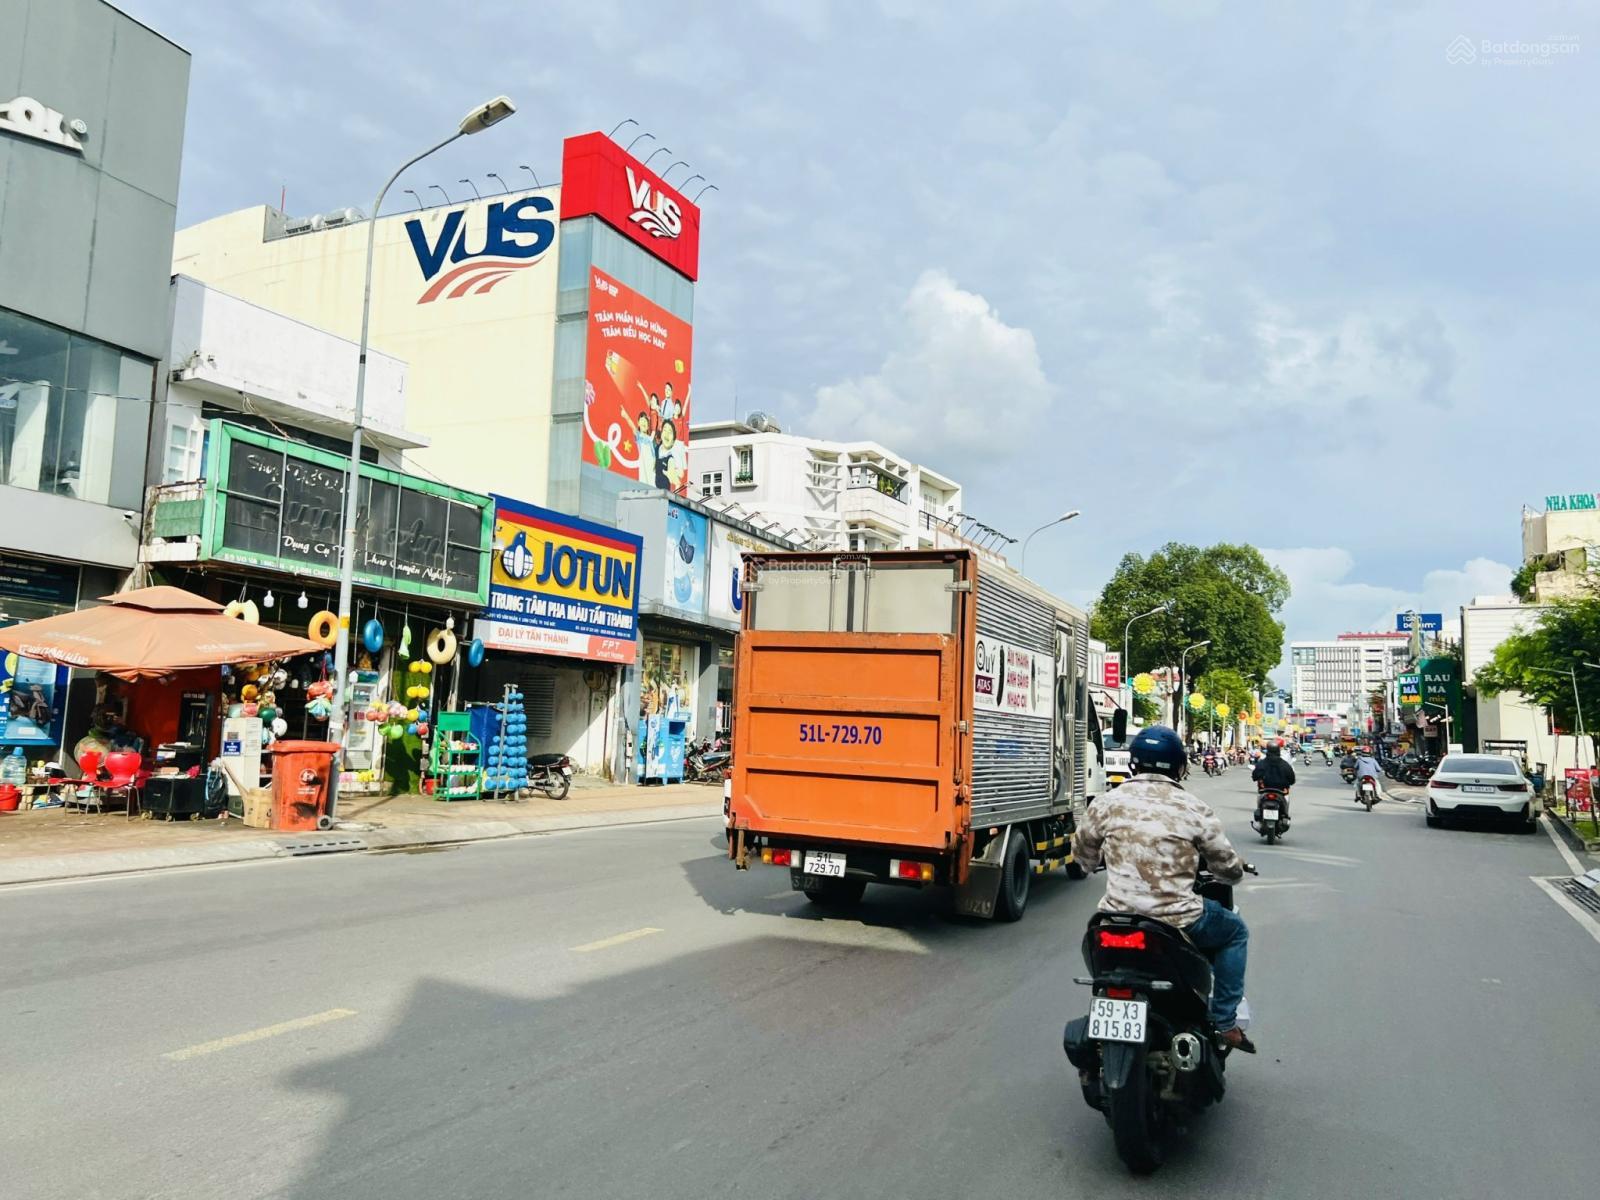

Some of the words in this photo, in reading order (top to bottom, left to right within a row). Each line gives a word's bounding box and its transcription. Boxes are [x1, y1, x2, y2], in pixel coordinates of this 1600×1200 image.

[625, 165, 682, 237] VUS
[404, 196, 555, 282] VUS
[1545, 496, 1567, 511] NHA
[1569, 494, 1596, 510] KHOA
[282, 535, 310, 553] Dụng
[314, 543, 330, 558] Cụ
[536, 541, 632, 599] JOTUN
[491, 591, 524, 612] TRUNG
[525, 595, 546, 616] TÂM
[547, 602, 566, 619] PHA
[567, 603, 588, 622] MÀU
[606, 610, 633, 629] THÀNH
[498, 627, 513, 639] ĐẠI
[515, 628, 525, 639] LÝ
[602, 640, 620, 651] FPT
[977, 678, 991, 691] ATAS
[1400, 676, 1419, 684] RAU
[1424, 674, 1450, 682] RAU
[799, 723, 882, 745] 51L-729.70
[816, 852, 834, 864] 51L
[808, 863, 840, 875] 729.70
[1098, 1000, 1138, 1020] 59-X3
[1092, 1018, 1141, 1040] 815.83
